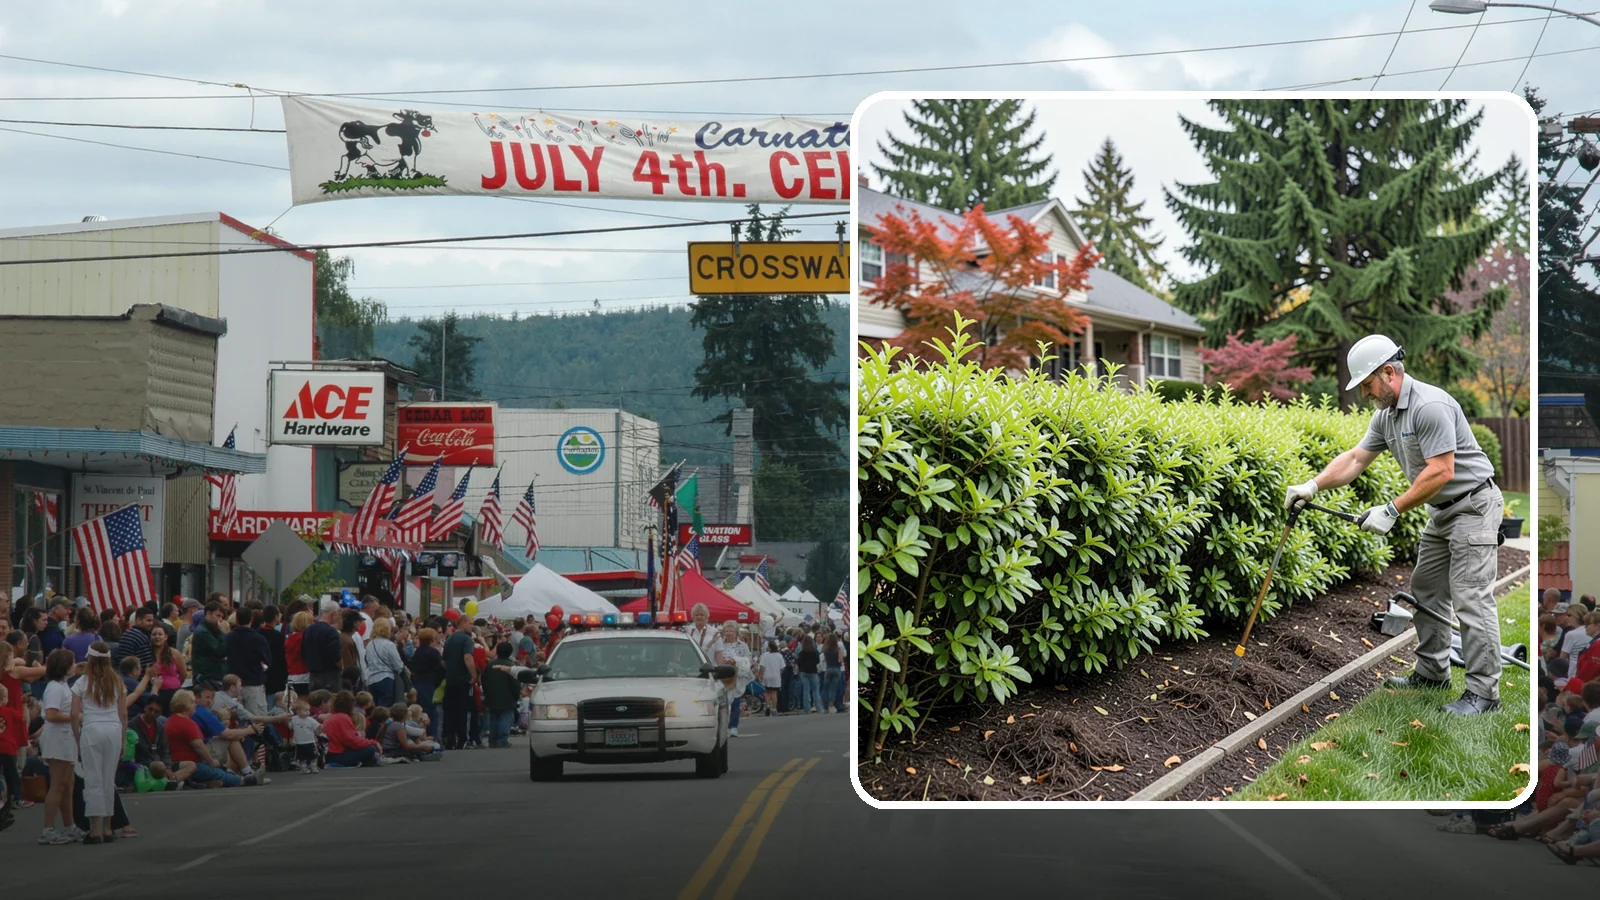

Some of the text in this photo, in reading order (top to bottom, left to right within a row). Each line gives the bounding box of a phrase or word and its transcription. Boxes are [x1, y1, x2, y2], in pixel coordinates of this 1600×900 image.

[481, 140, 604, 193] JULY
[632, 150, 747, 198] 4th.
[697, 254, 850, 280] CROSSWA
[283, 380, 373, 420] ACE
[406, 409, 452, 422] CEDAR
[284, 421, 371, 436] Hardware
[416, 428, 477, 447] Coca-Cola
[353, 467, 385, 479] Simpl
[96, 485, 124, 494] Vincent
[126, 486, 136, 495] de
[138, 486, 155, 495] Paul
[213, 516, 331, 535] HARDARE
[688, 526, 741, 535] CRNATION
[699, 535, 730, 543] GLASS
